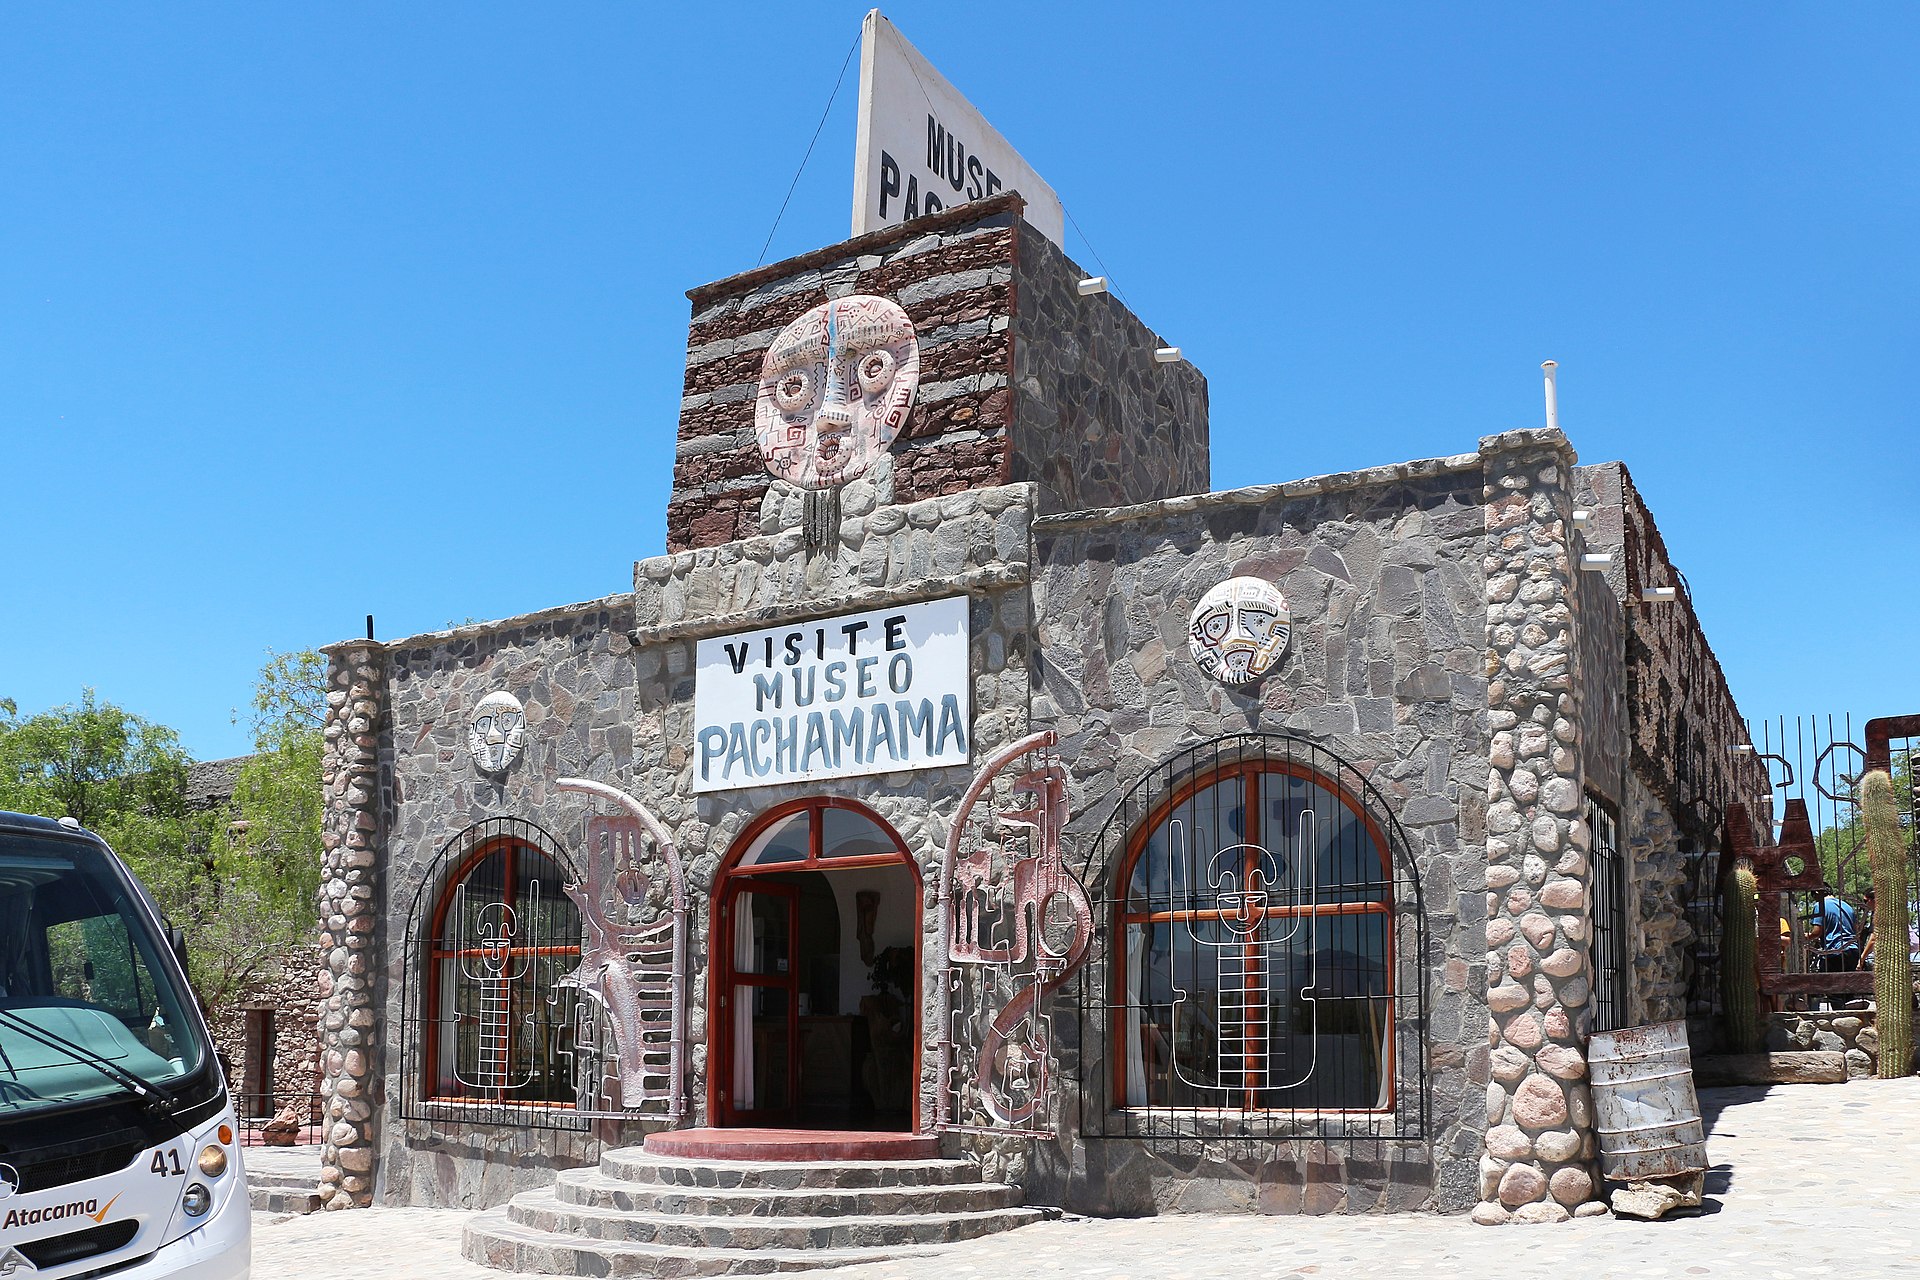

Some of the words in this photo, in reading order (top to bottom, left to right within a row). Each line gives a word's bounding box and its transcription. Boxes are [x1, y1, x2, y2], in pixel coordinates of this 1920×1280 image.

[724, 615, 907, 674] VISITE
[753, 652, 913, 713] MUSEO
[698, 694, 967, 782] PACHAMAMA
[150, 1148, 186, 1178] 41
[2, 1198, 98, 1230] Atacama
